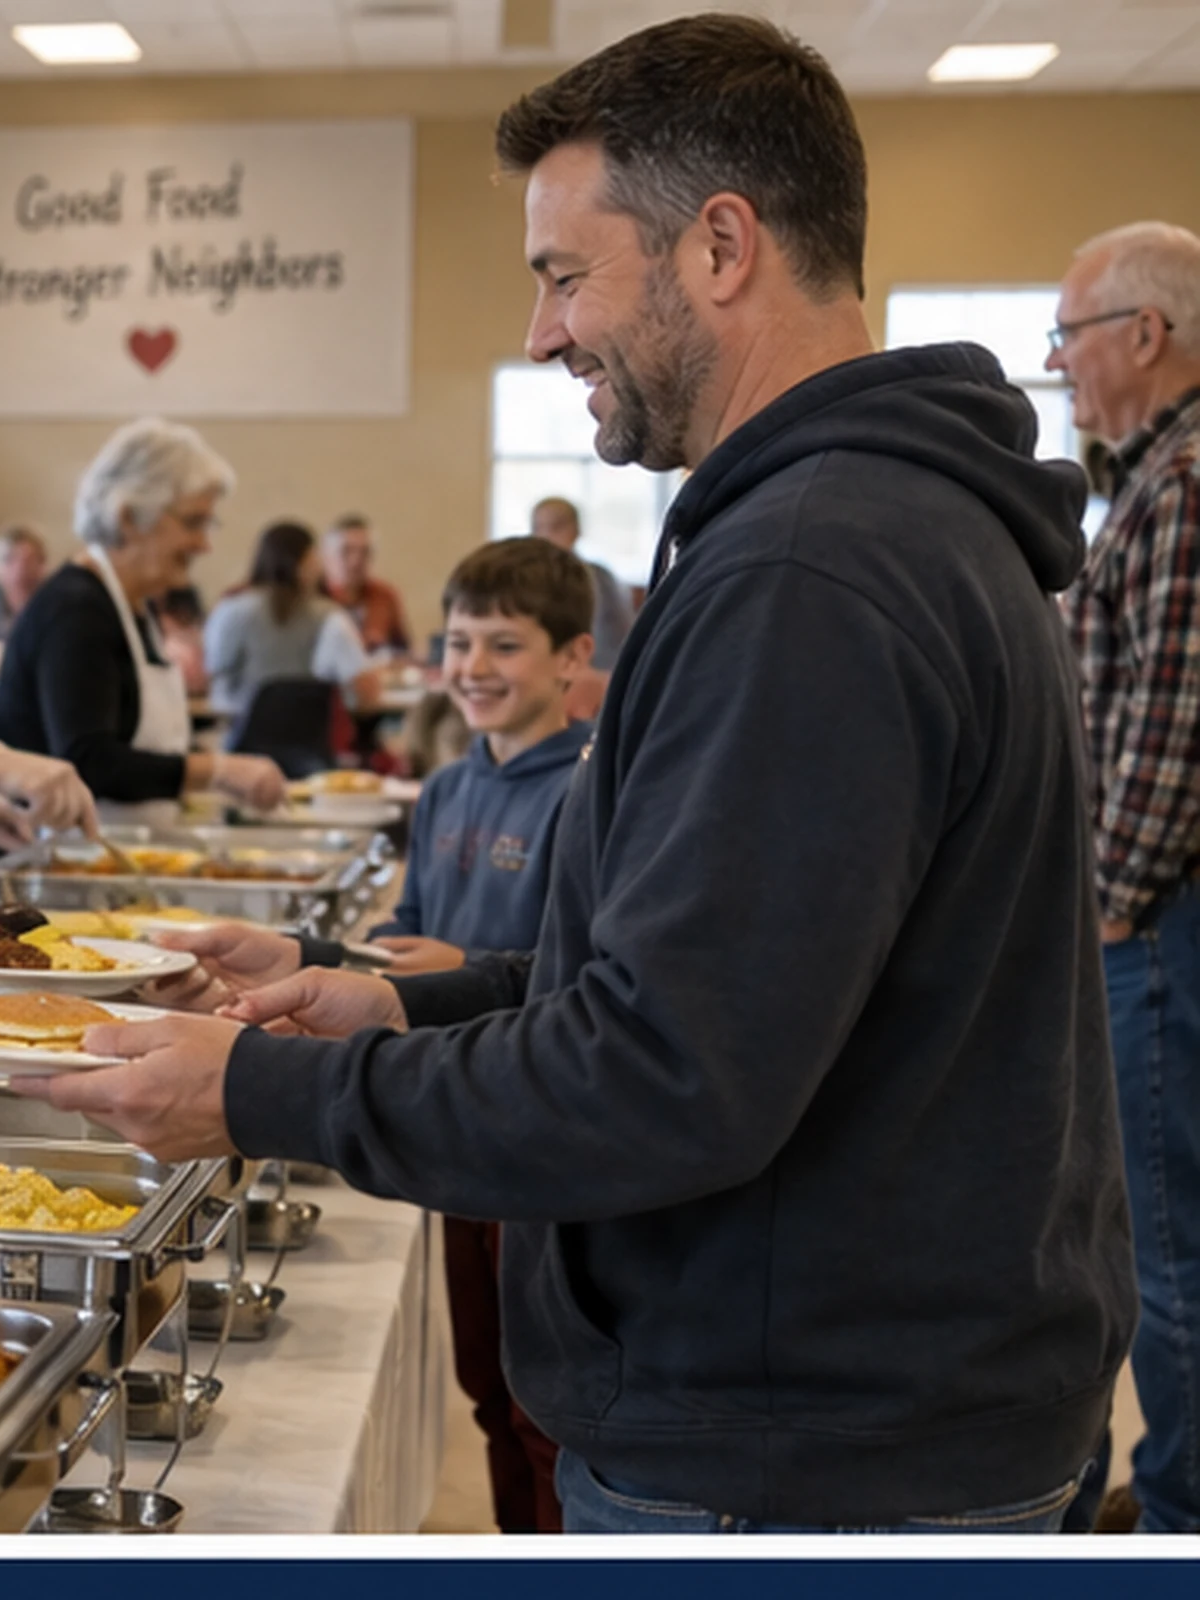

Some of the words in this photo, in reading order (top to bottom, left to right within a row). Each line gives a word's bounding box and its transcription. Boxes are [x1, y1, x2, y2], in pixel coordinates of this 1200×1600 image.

[16, 173, 123, 232] Good
[147, 164, 243, 222] Food
[149, 240, 344, 315] Neighbors
